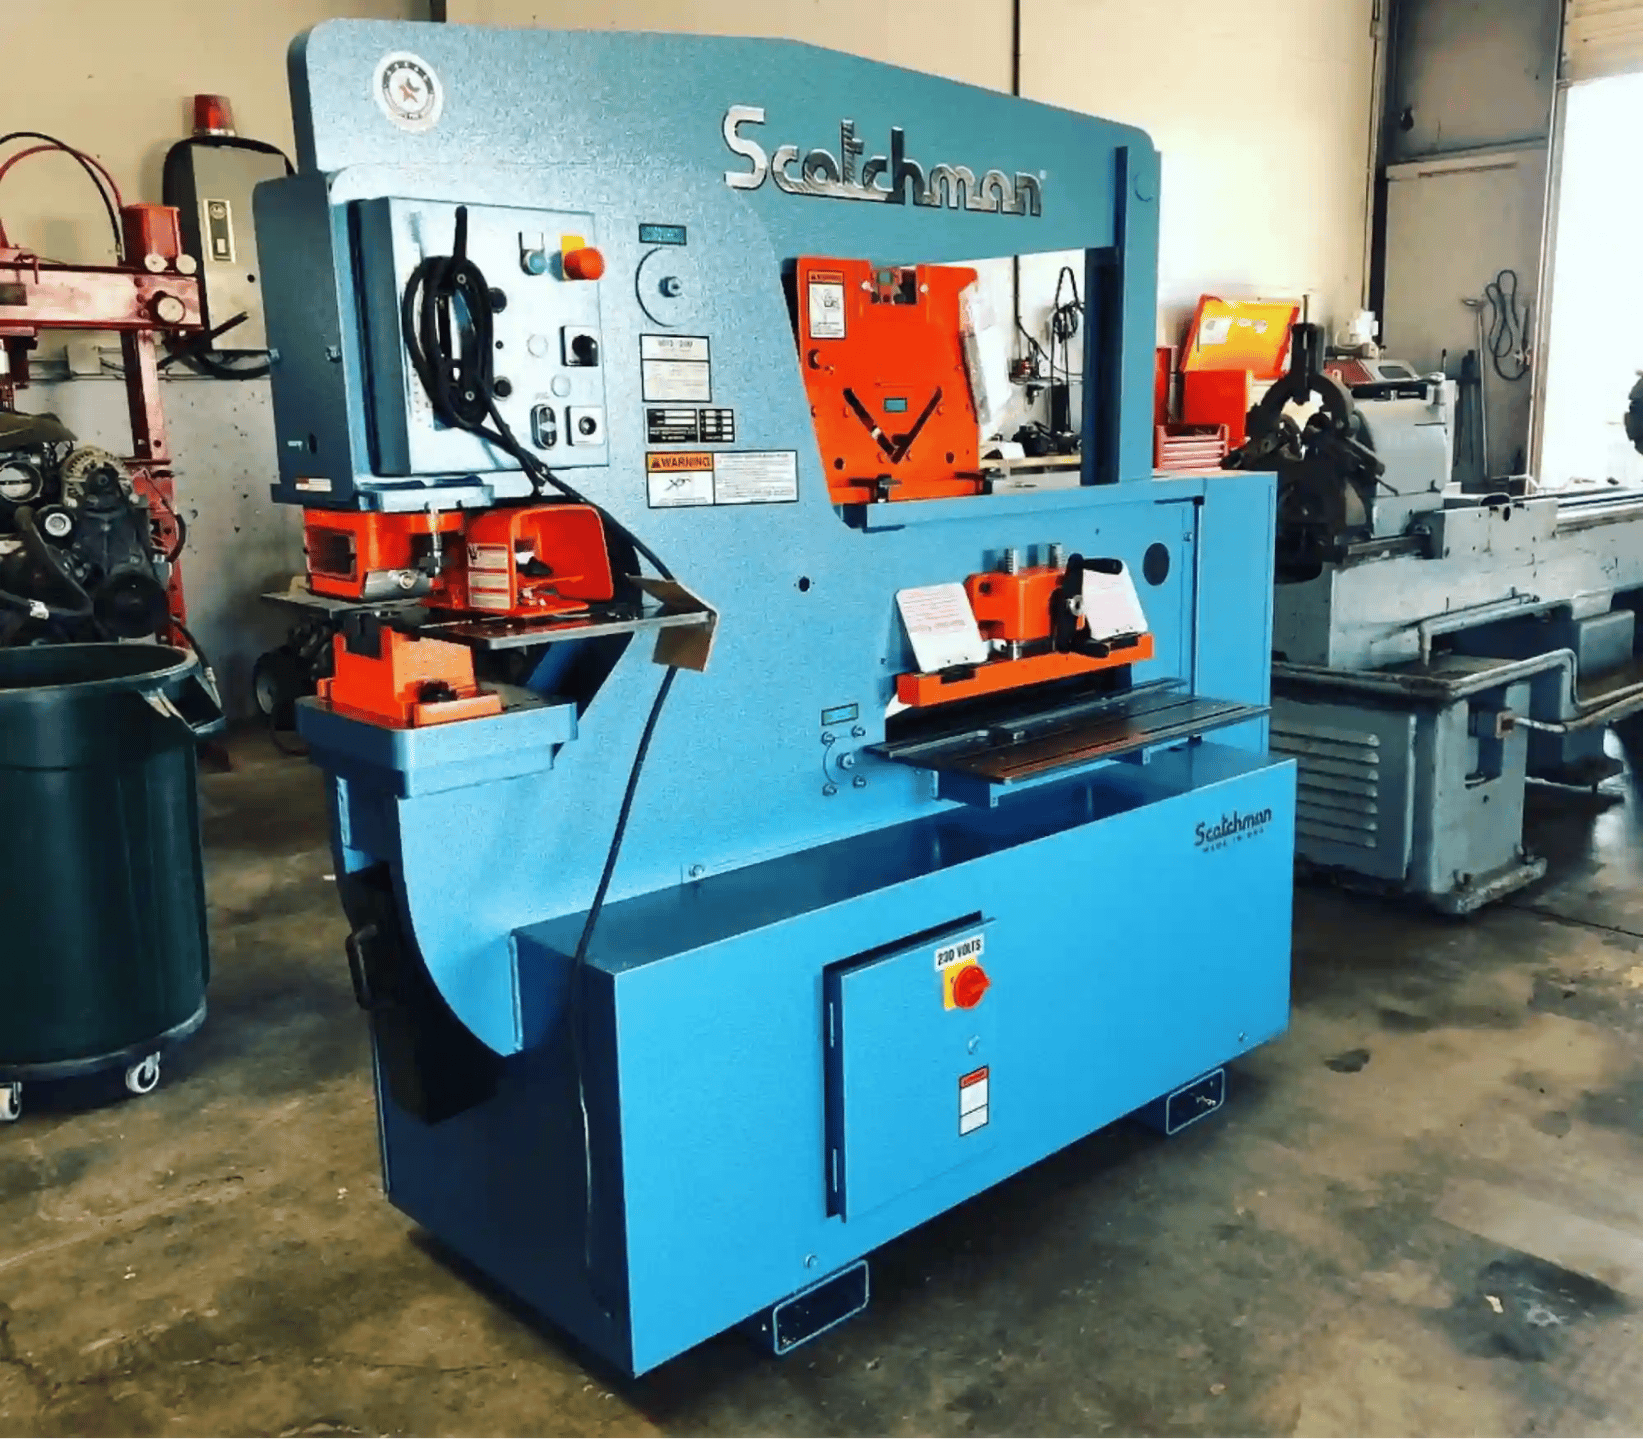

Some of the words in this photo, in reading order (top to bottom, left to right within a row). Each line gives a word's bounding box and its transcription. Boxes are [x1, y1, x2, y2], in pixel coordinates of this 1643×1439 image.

[722, 104, 1042, 217] Scotchman
[661, 455, 711, 469] WARNING
[1194, 808, 1272, 847] Scotchman
[937, 948, 955, 966] 230
[956, 938, 982, 958] VOLTS
